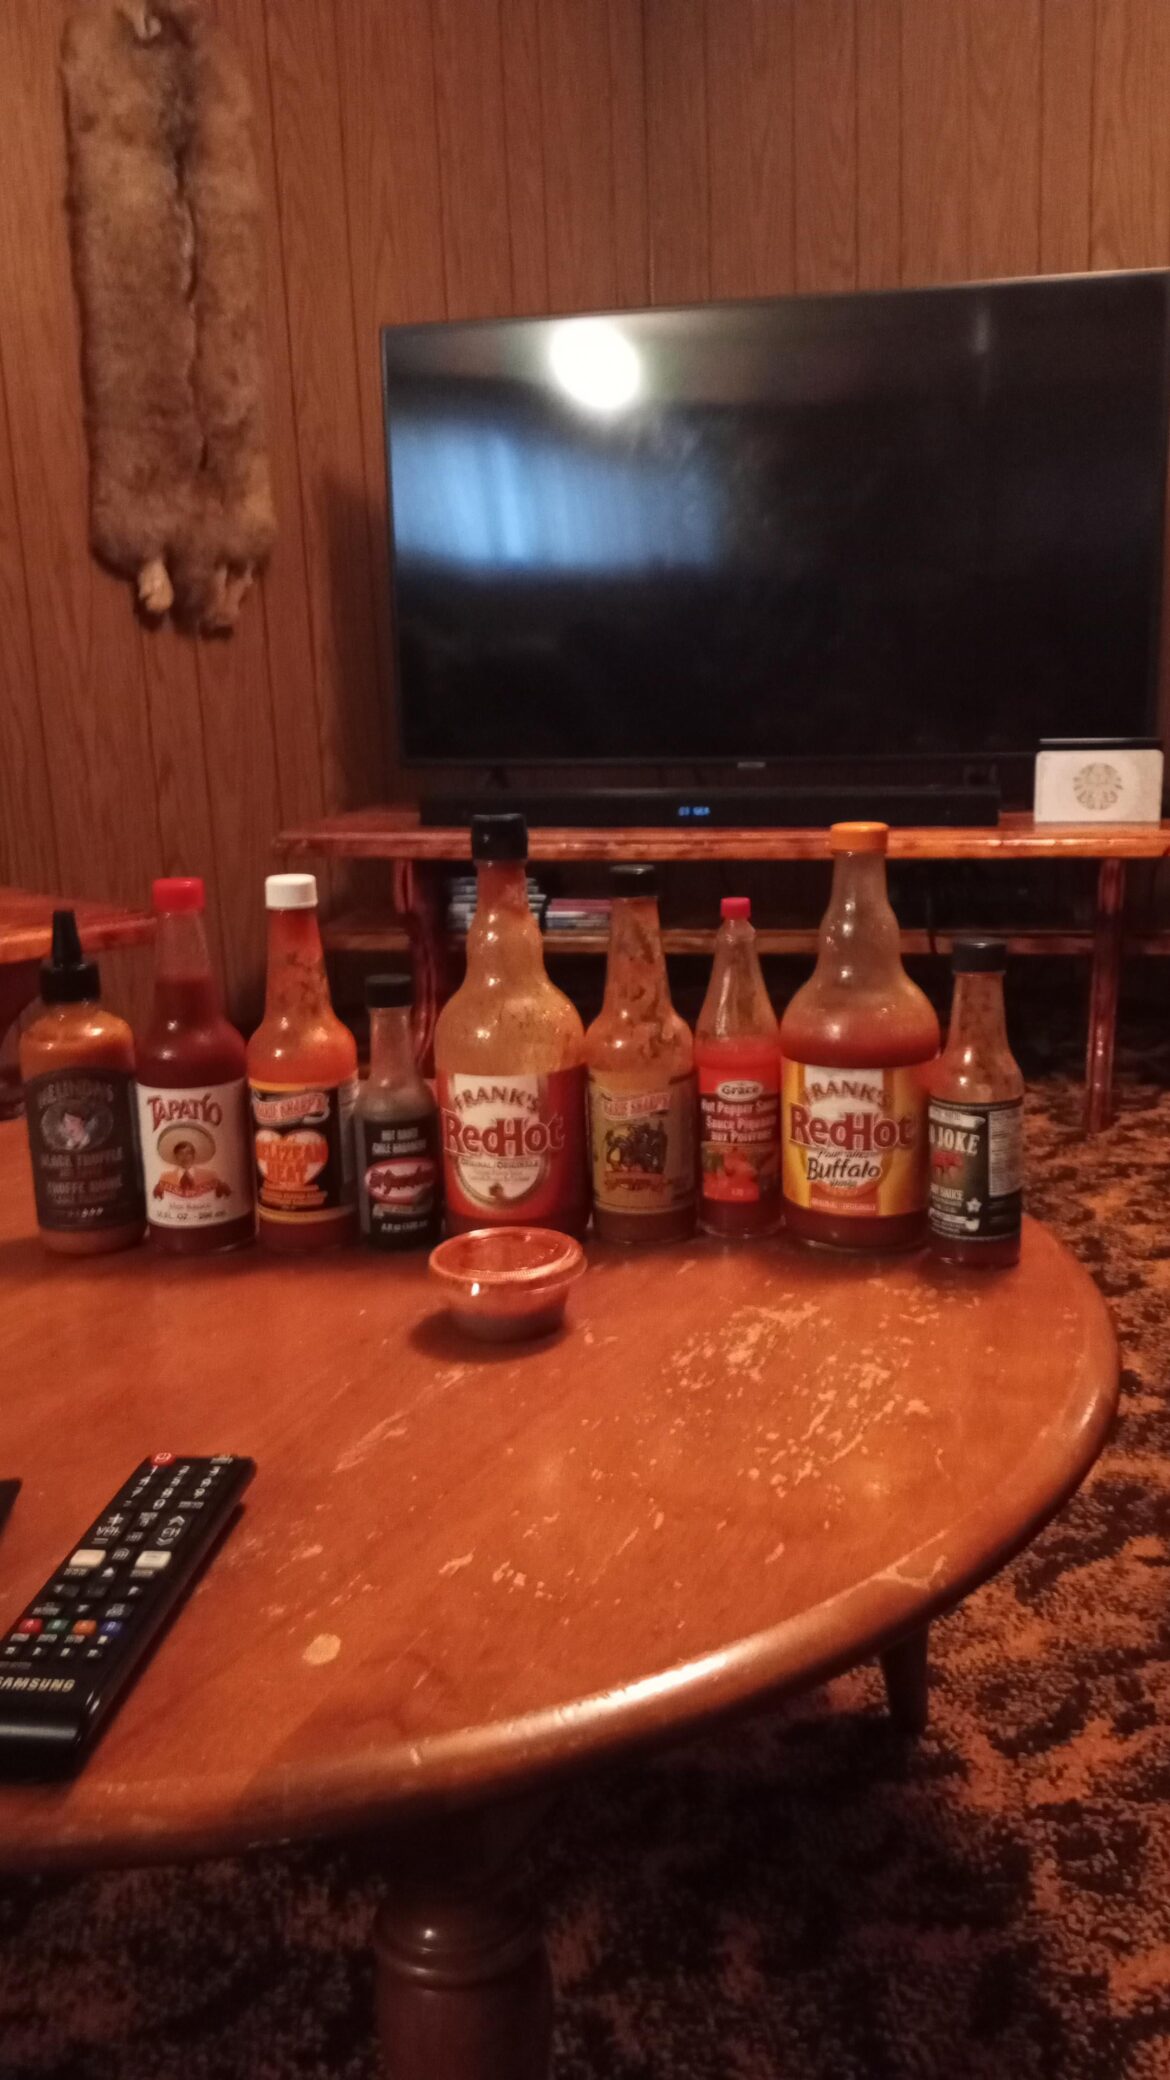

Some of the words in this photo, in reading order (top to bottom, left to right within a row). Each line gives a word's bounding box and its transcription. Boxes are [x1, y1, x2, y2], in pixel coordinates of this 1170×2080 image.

[454, 1086, 539, 1114] FRANK'S
[721, 1085, 760, 1096] Grace
[804, 1080, 893, 1110] FRANK'S
[442, 1108, 566, 1157] RedHot
[790, 1103, 914, 1151] RedHot
[937, 1126, 981, 1156] JOKE
[806, 1156, 881, 1181] Buffalo
